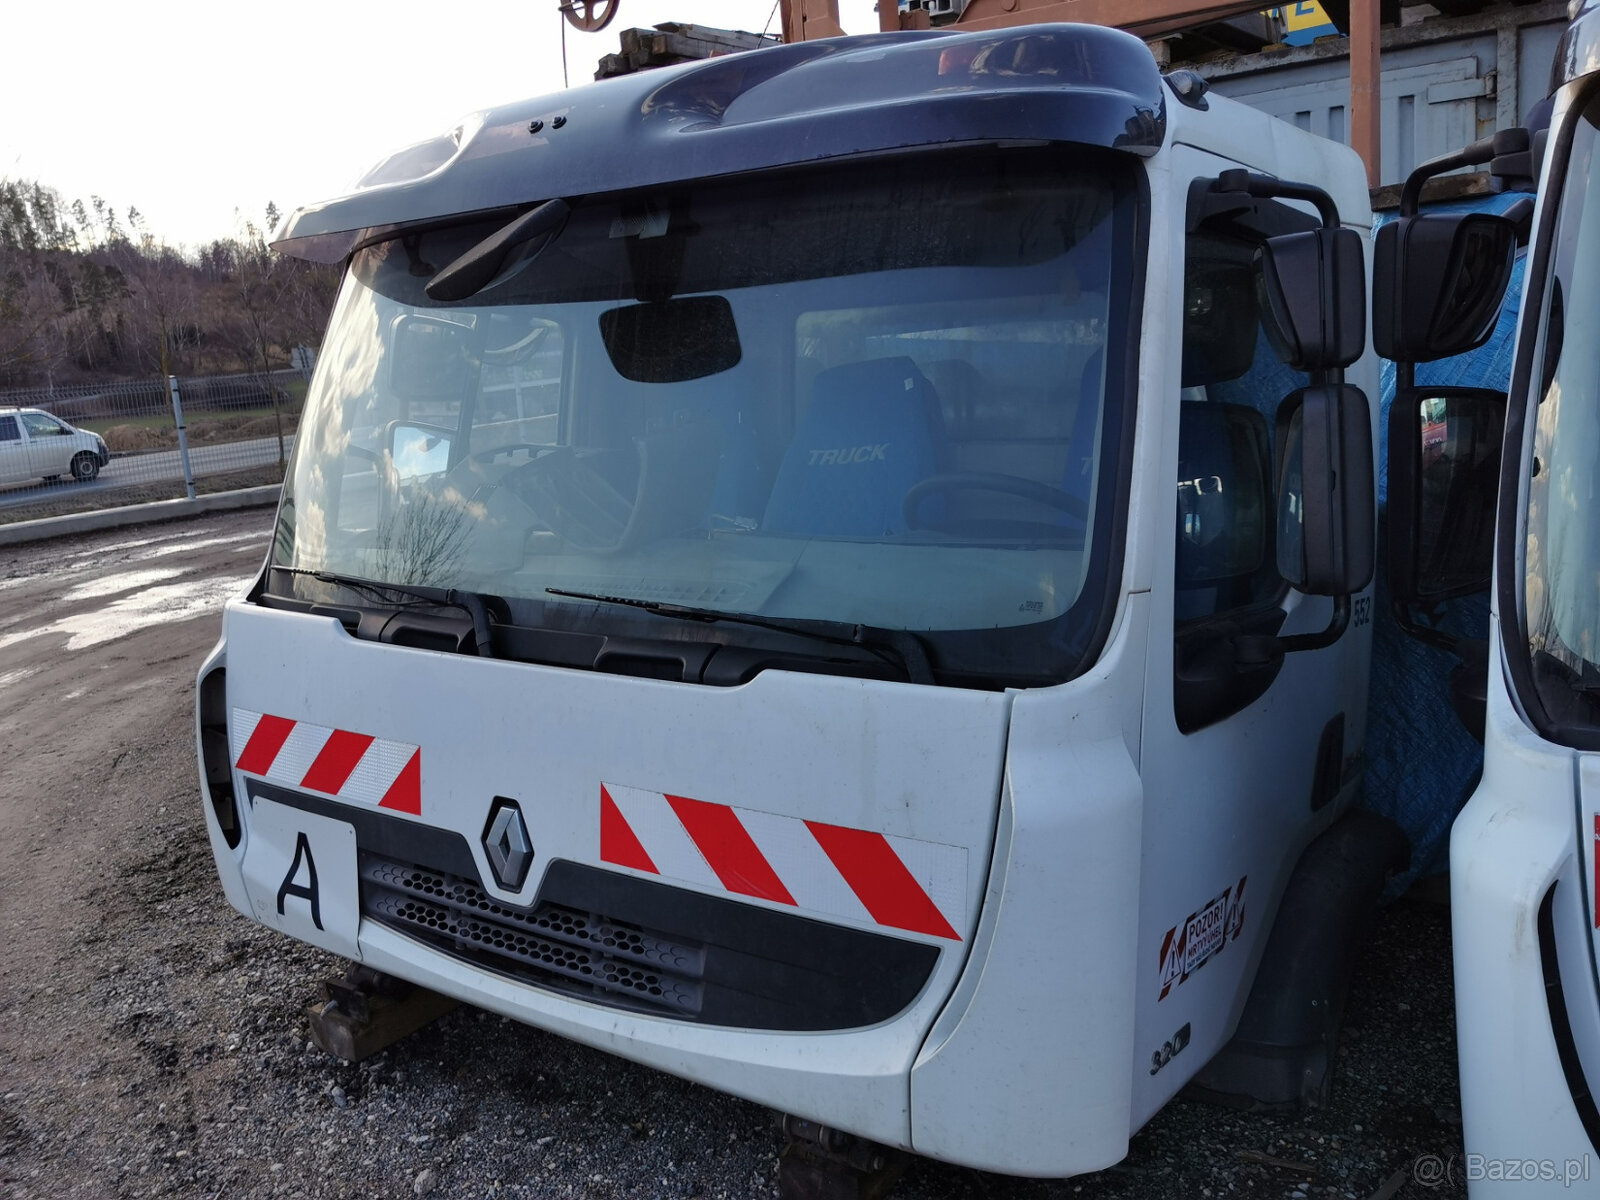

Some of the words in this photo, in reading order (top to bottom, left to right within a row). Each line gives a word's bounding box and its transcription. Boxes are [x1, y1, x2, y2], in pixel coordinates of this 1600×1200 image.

[808, 441, 891, 466] TRUCK
[1354, 596, 1370, 628] 552
[277, 831, 325, 931] A
[1189, 902, 1224, 943] POZOR!
